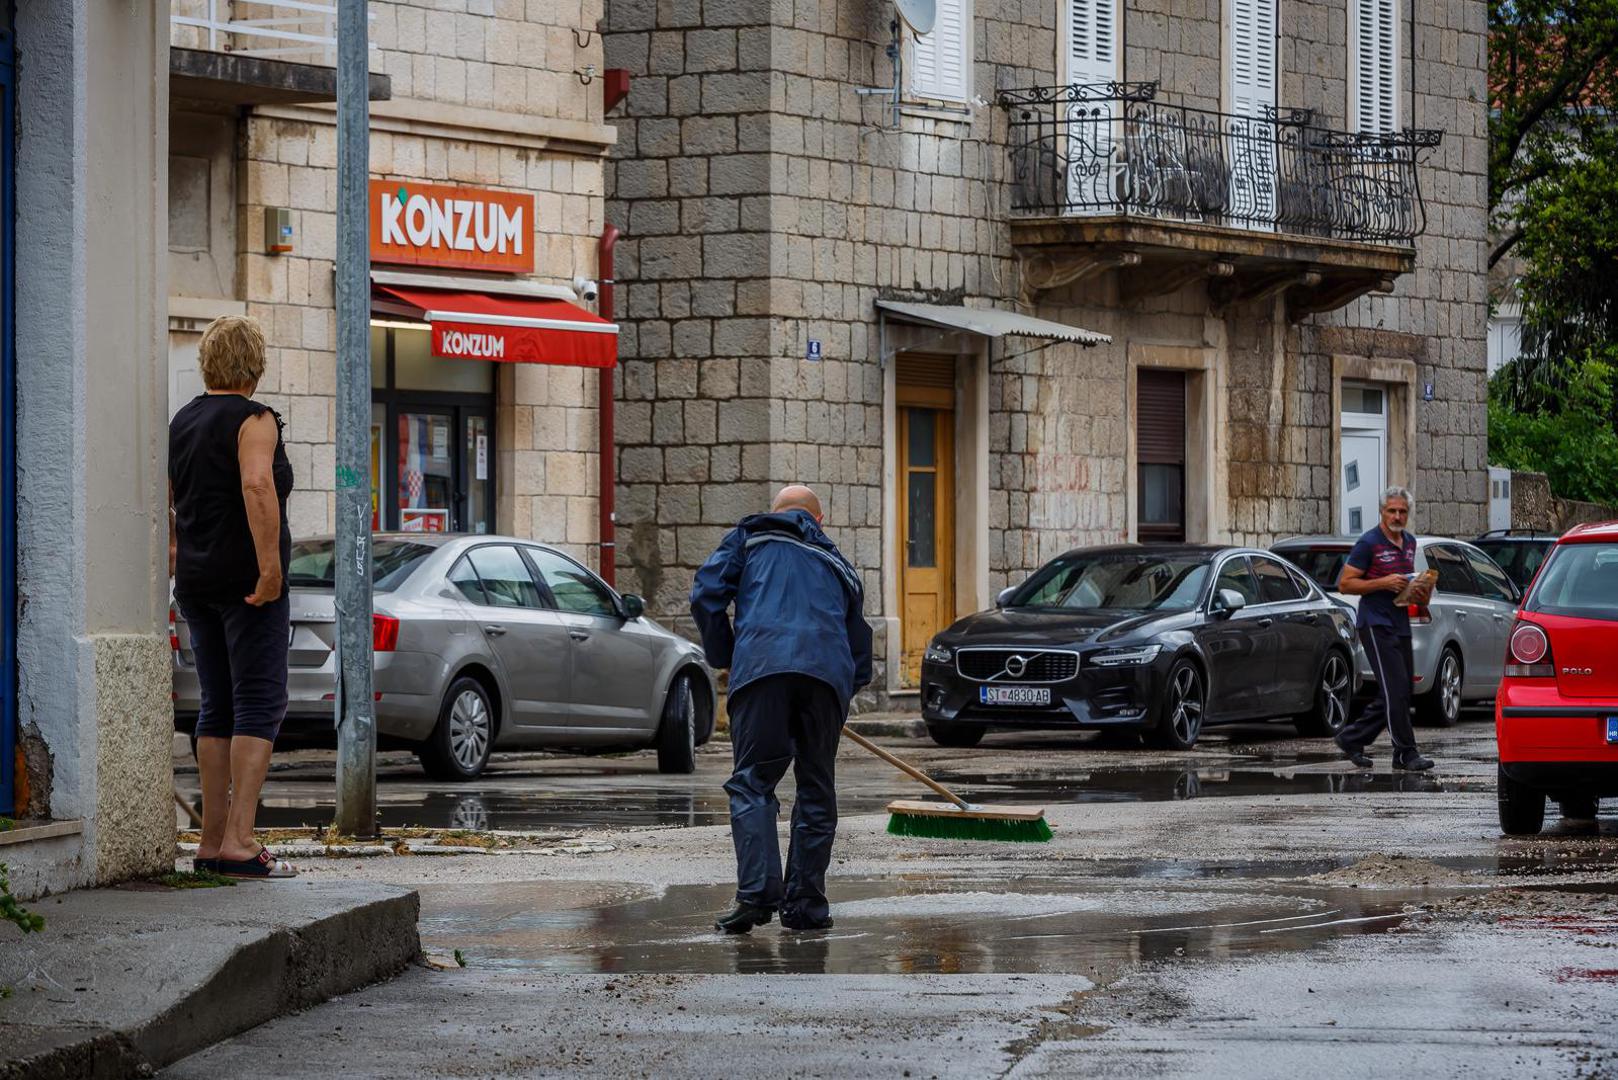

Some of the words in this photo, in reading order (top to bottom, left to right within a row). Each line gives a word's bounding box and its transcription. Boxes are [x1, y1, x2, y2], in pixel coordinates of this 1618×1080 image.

[382, 193, 523, 255] KONZUM
[442, 330, 505, 357] KONZUM
[811, 342, 818, 353] 6
[1562, 667, 1592, 675] POLO
[988, 688, 1000, 700] ST
